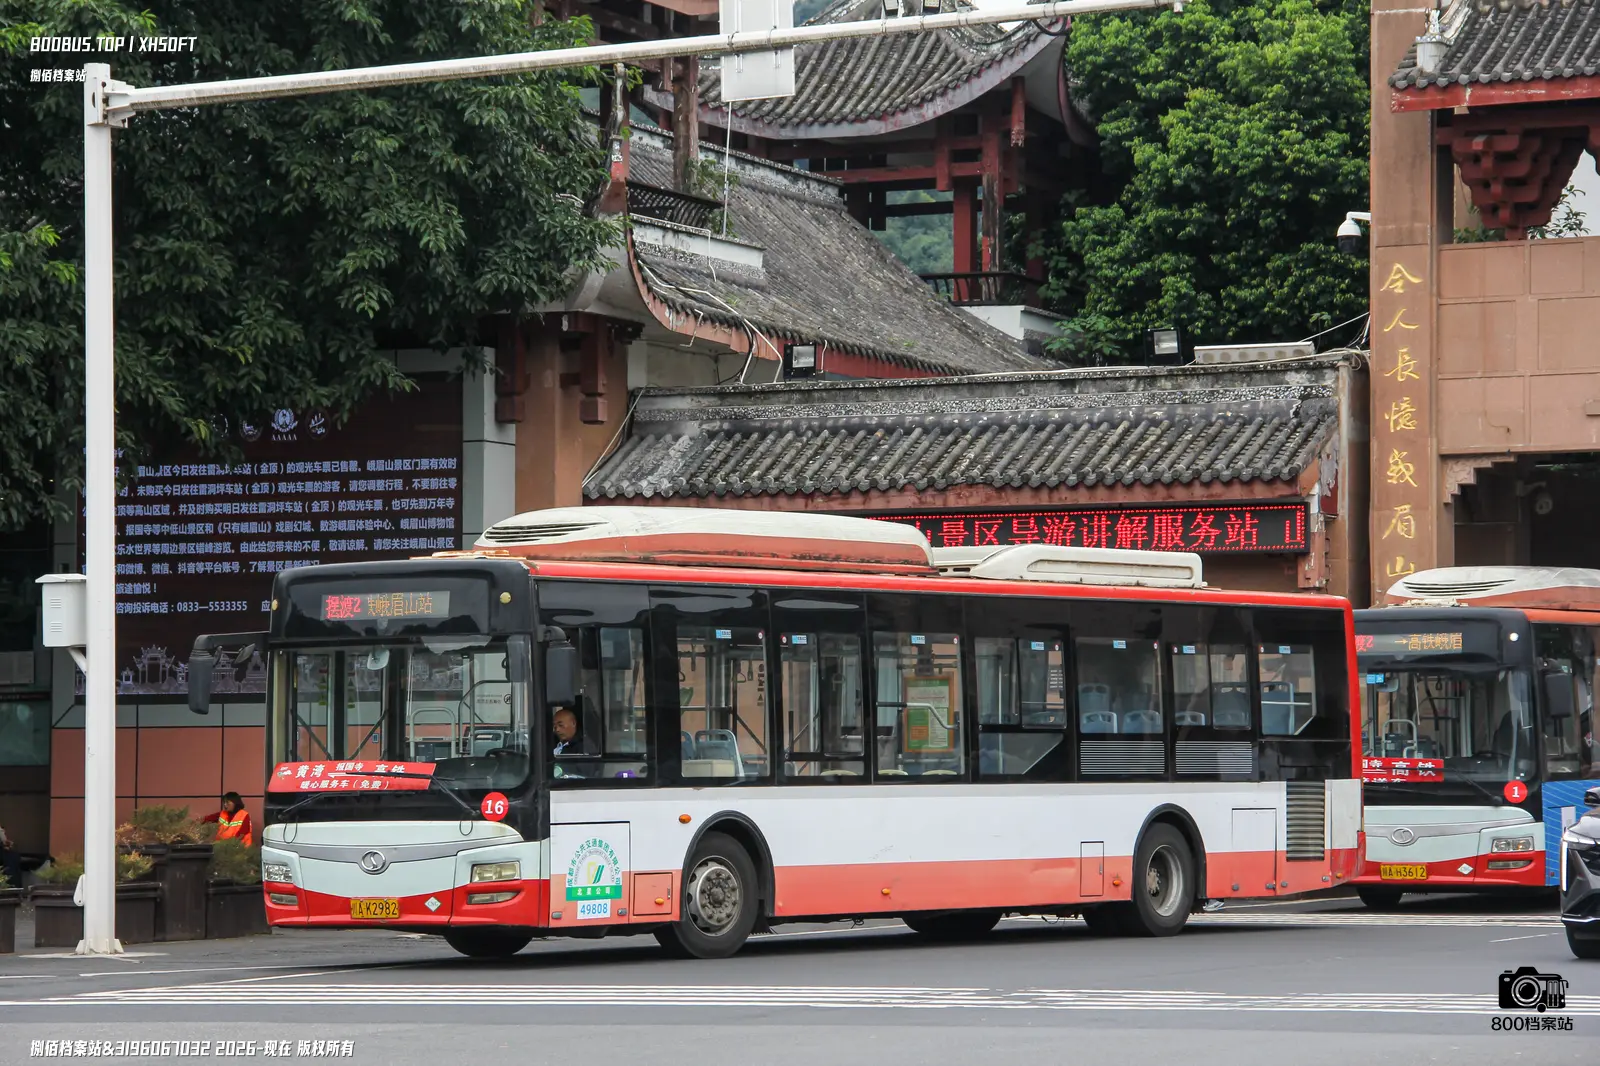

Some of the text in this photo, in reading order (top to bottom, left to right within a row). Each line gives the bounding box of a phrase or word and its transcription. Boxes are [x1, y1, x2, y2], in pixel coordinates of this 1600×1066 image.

[296, 764, 325, 778] 黄湾
[335, 762, 364, 771] 报国寺
[1512, 786, 1520, 798] 1
[485, 799, 504, 814] 16
[580, 903, 608, 915] 49808
